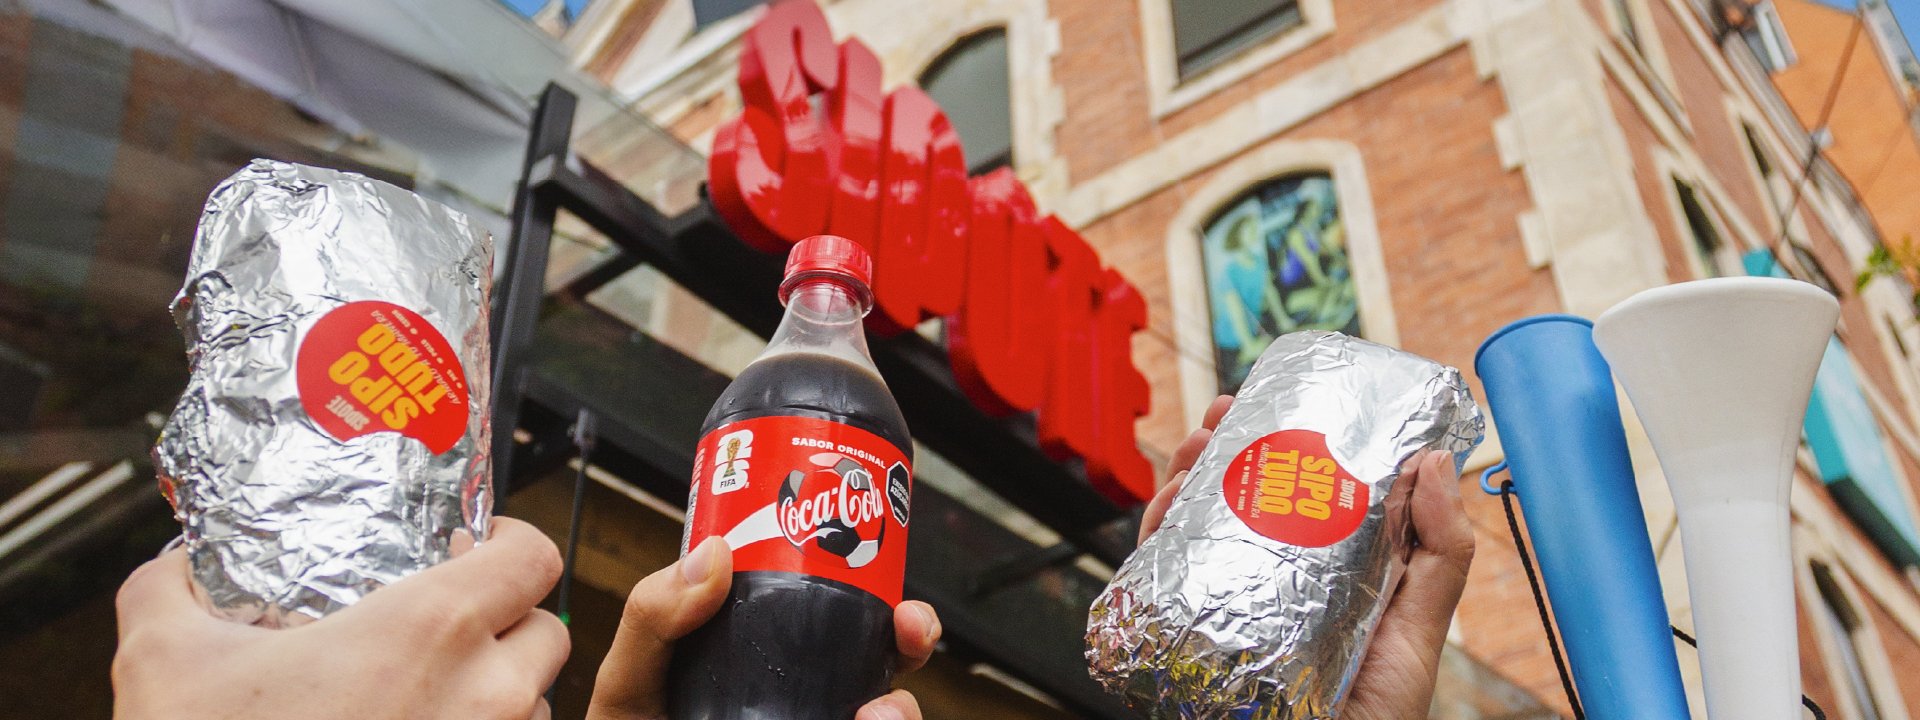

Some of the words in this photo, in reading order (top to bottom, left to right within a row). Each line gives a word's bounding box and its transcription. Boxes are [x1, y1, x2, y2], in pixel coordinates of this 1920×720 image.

[328, 351, 420, 430] SIPO
[357, 323, 447, 415] TUDO
[720, 478, 736, 488] FIFA
[791, 437, 834, 451] SABOR
[837, 444, 886, 469] ORIGINAL
[1259, 450, 1299, 515] TUDO
[780, 468, 884, 543] Coca-Cola
[1295, 455, 1337, 521] SIPO
